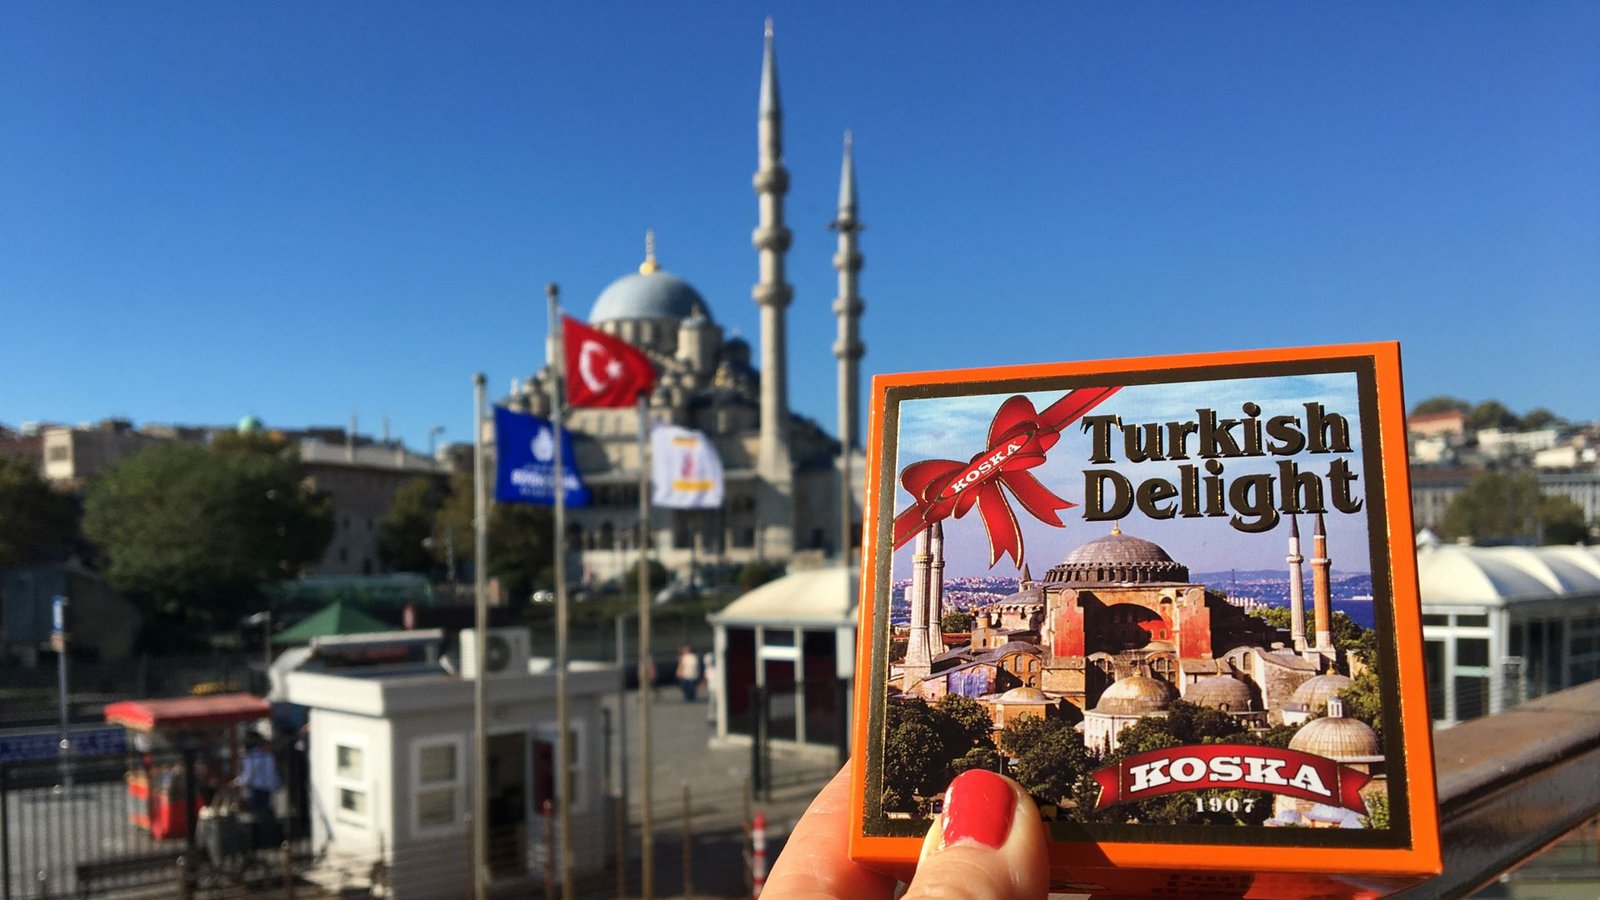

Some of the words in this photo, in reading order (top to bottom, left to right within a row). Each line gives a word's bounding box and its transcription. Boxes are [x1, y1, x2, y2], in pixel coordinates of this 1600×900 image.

[1080, 402, 1353, 464] Turkish
[951, 443, 1021, 493] KOSKA
[1082, 457, 1364, 533] Delight
[1129, 756, 1332, 797] KOSKA
[1195, 797, 1255, 813] 1907
